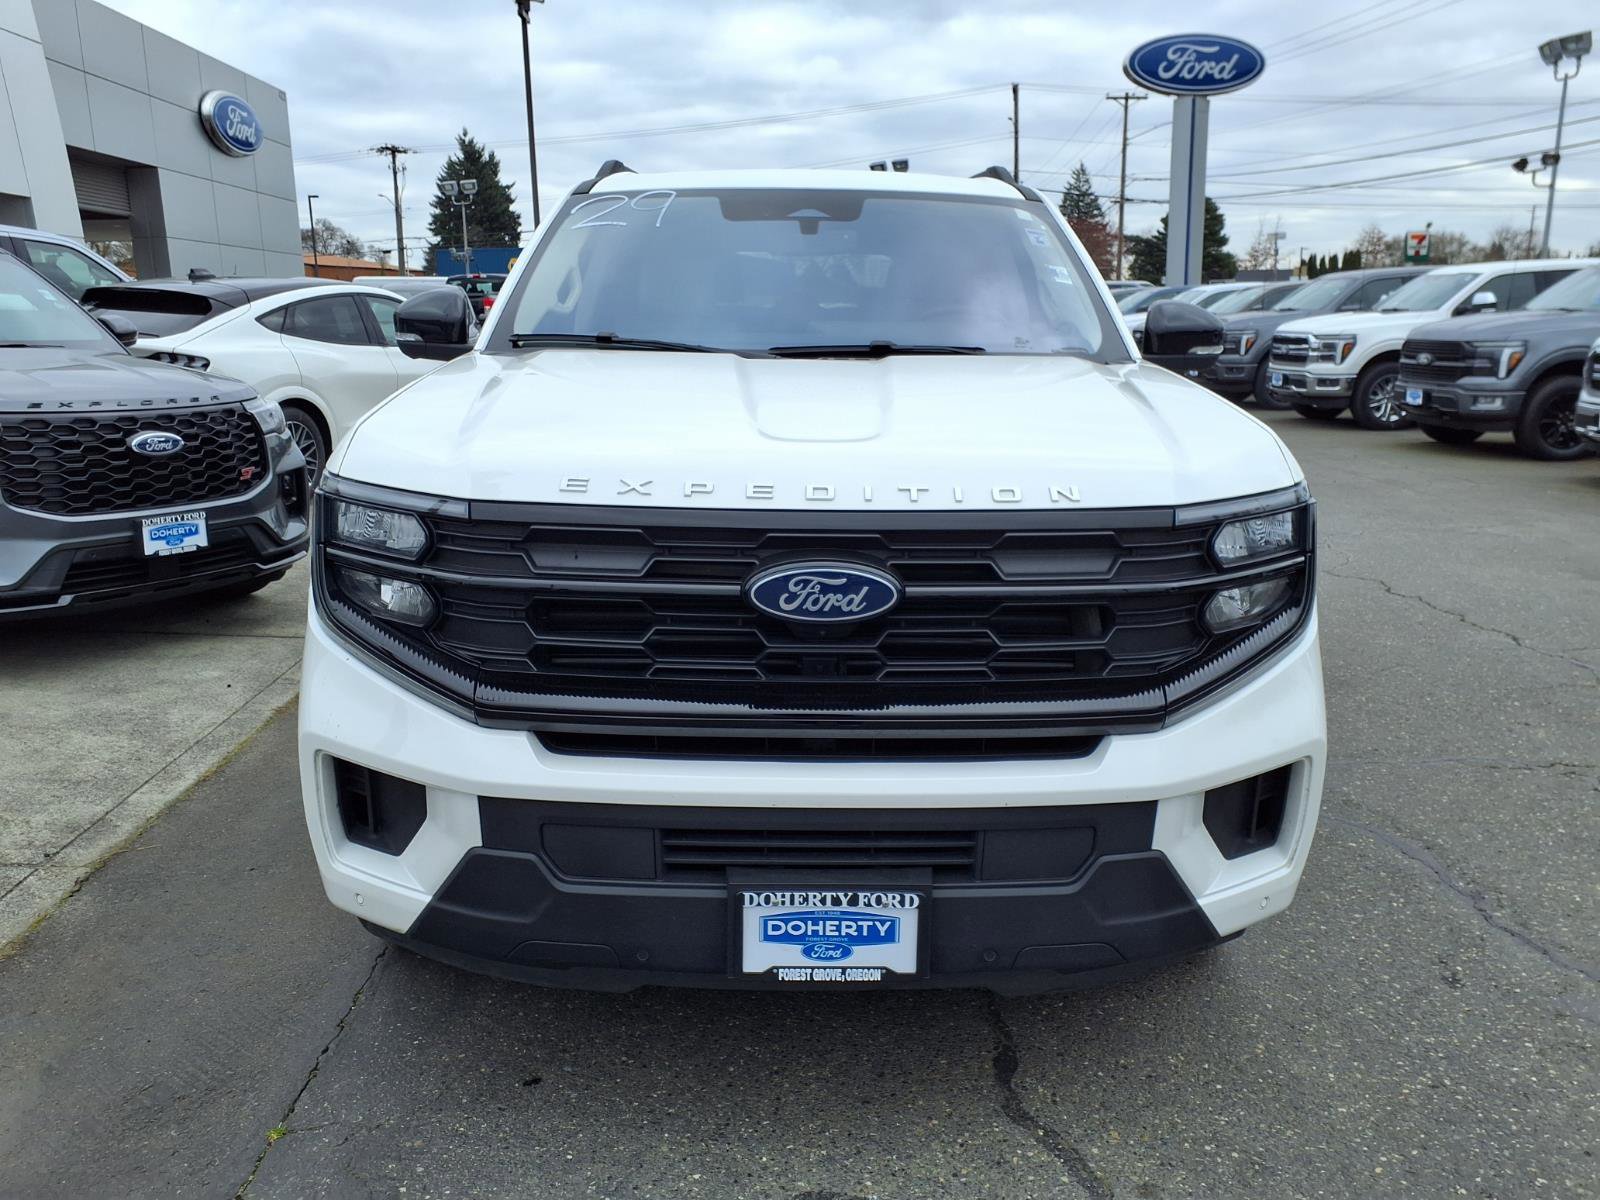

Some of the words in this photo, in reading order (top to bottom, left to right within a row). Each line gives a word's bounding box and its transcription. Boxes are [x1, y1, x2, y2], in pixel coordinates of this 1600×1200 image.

[1157, 43, 1240, 80] Ford
[226, 104, 257, 144] Ford
[570, 189, 677, 229] 29
[27, 395, 220, 409] EXPLORER
[146, 437, 173, 451] Ford
[559, 476, 1082, 502] EXPEDITION
[142, 514, 183, 526] DOHERTY
[183, 511, 207, 521] FORD
[151, 525, 197, 539] DOHERTY
[778, 575, 870, 612] Ford
[743, 892, 852, 908] DOHERTY
[858, 892, 920, 909] FORD
[767, 920, 892, 937] DOHERTY
[810, 944, 843, 959] Ford
[778, 968, 812, 981] FOREST
[813, 968, 845, 982] GROVE,
[845, 968, 881, 981] OREGON
